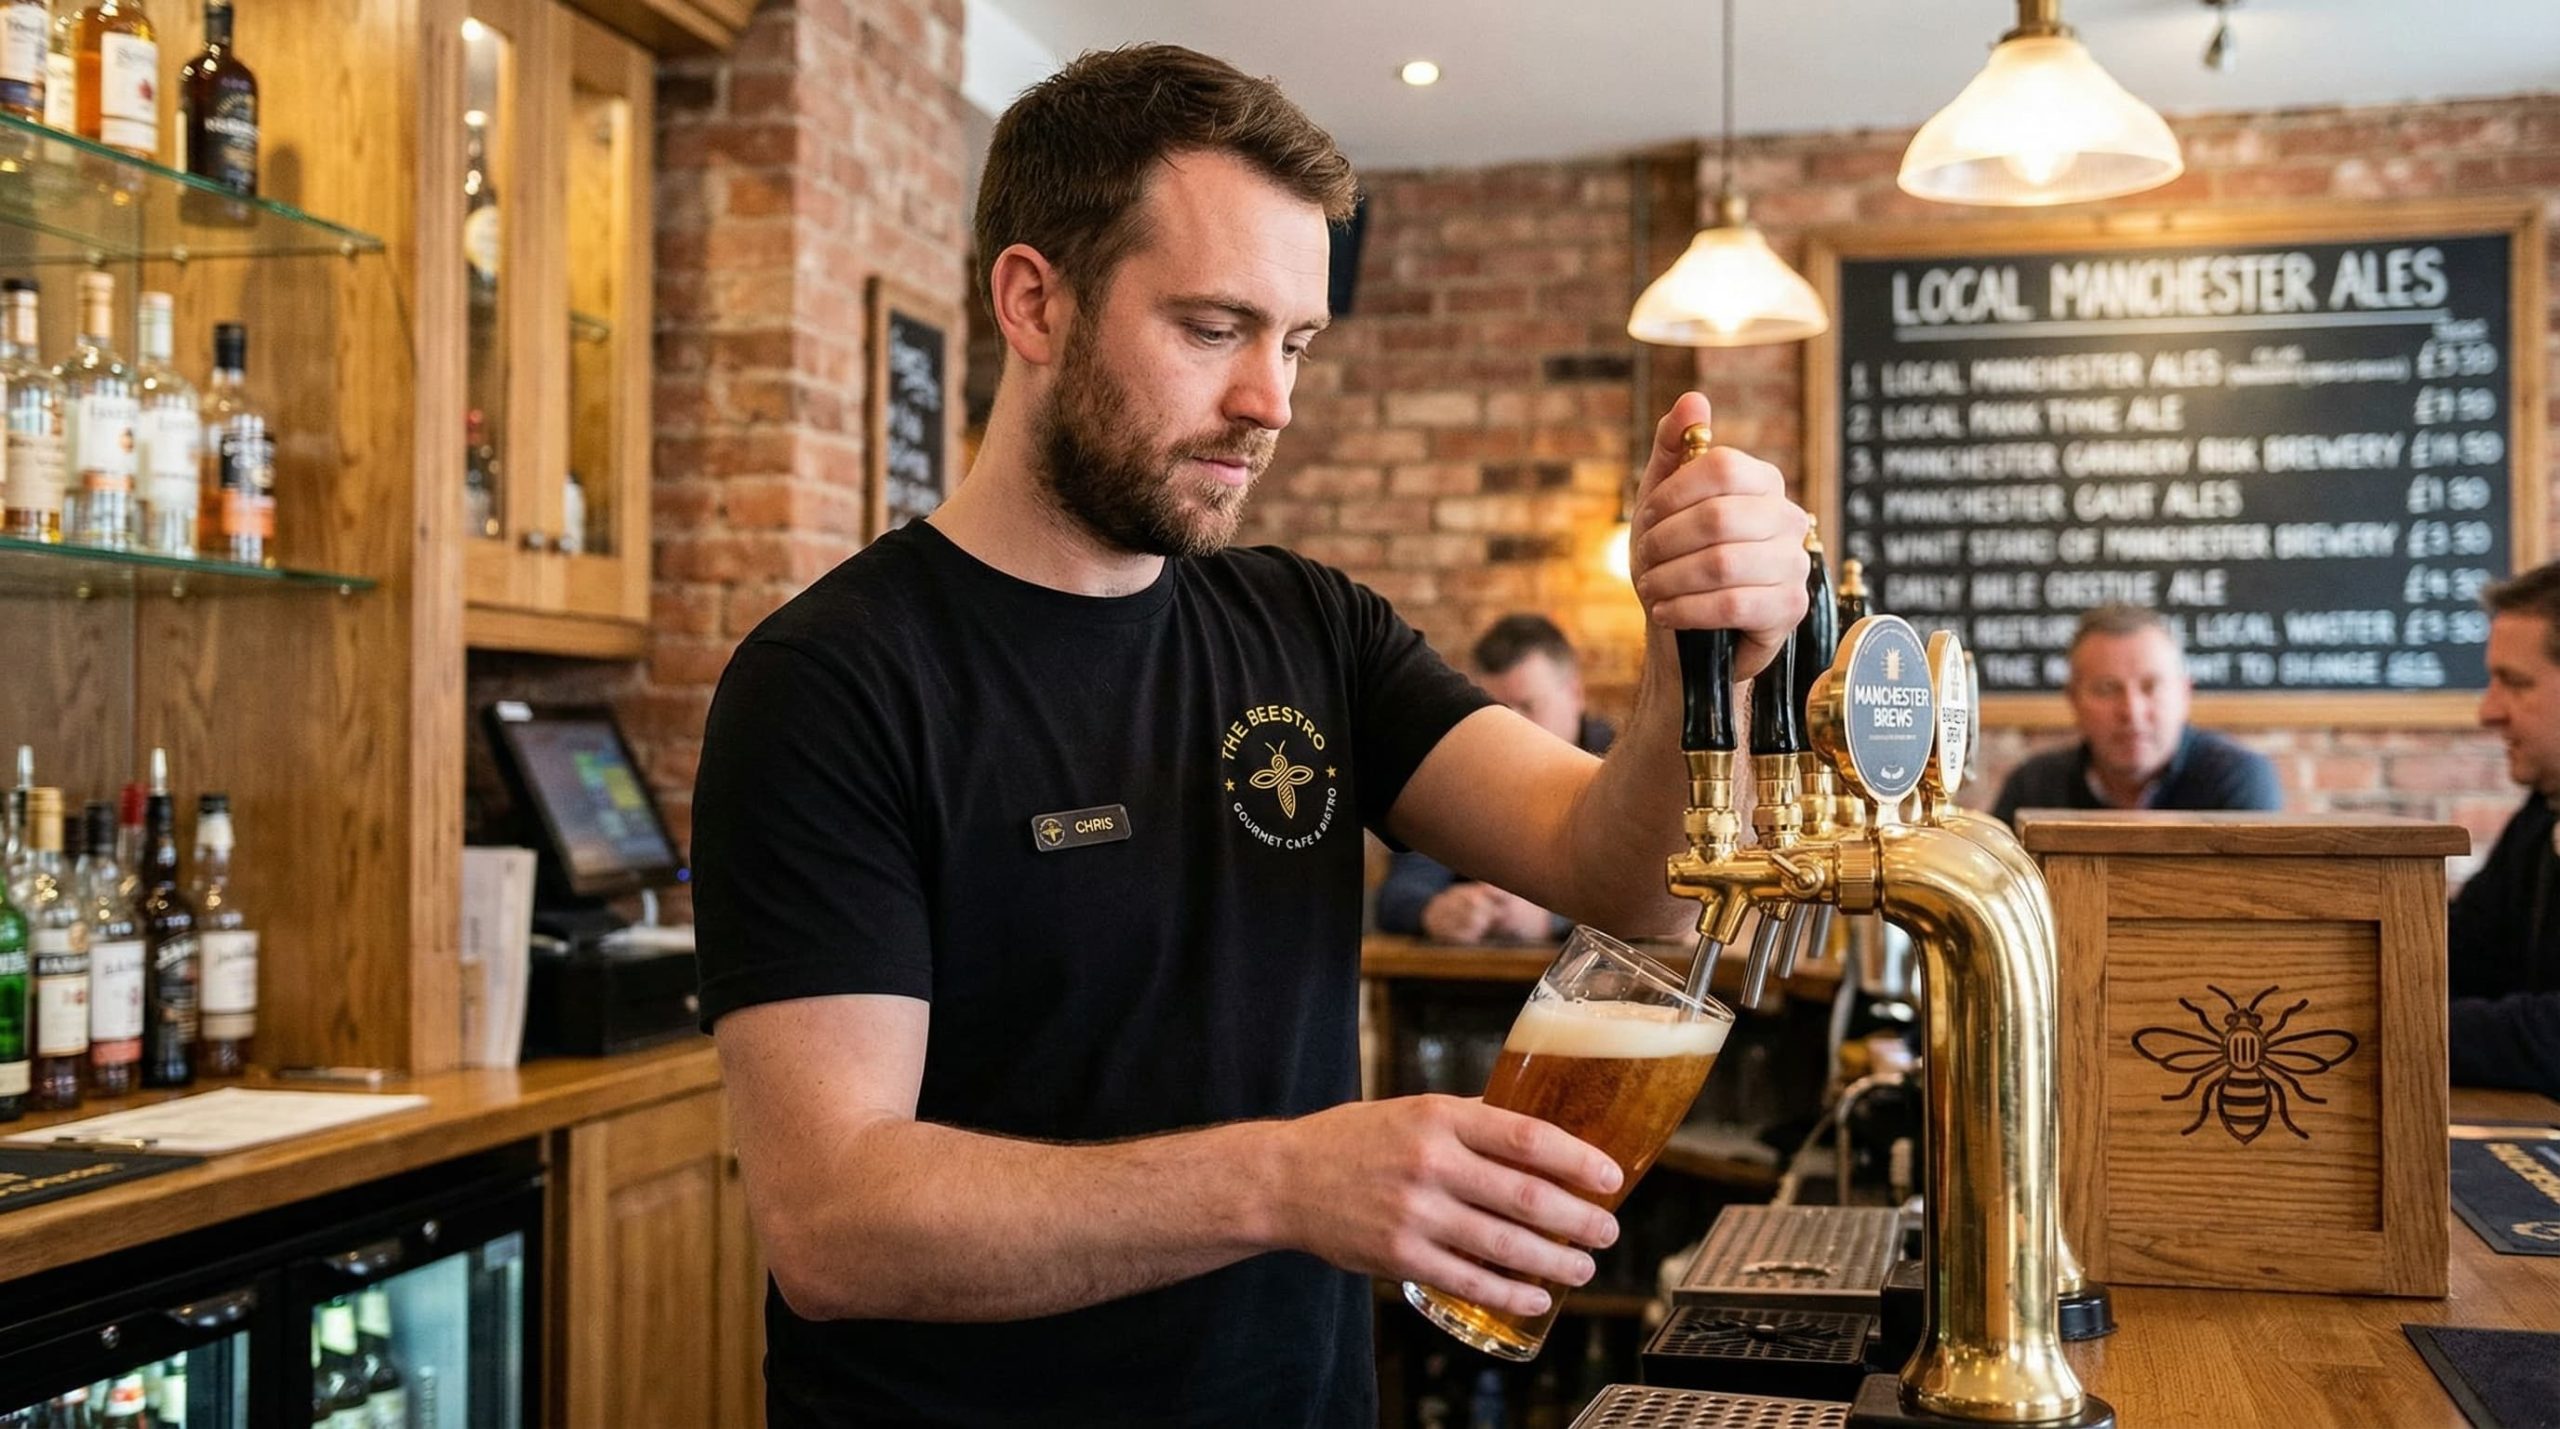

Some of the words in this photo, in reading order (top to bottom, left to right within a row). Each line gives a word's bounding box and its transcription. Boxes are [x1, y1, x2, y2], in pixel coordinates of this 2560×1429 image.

[1891, 265, 2034, 325] LOCAL
[2050, 252, 2316, 318] MANCHESTER
[2329, 246, 2449, 310] ALES
[1881, 359, 1967, 397] LOCAL
[1970, 350, 2145, 392] MANCHESTER
[2150, 347, 2223, 388] ALES
[1881, 403, 1966, 440] LOCAL
[2125, 393, 2186, 432] ALE
[1882, 442, 2060, 481] MANCHESTER
[2263, 431, 2405, 473] BREWERY
[1882, 483, 2067, 525] MANCHESTER
[2161, 479, 2244, 519] ALES
[2103, 524, 2272, 563] MANCHESTER
[2275, 521, 2399, 560] BREWERY
[2165, 568, 2229, 606] ALE
[2195, 611, 2280, 648] LOCAL
[1855, 684, 1929, 706] MANCHESTER
[1873, 707, 1914, 728] BREWS
[1221, 720, 1249, 760] THE
[1245, 705, 1326, 751] BEESTRO
[1075, 817, 1115, 835] CHRIS
[1233, 802, 1283, 848] GOURMET
[1285, 834, 1315, 850] CAFE
